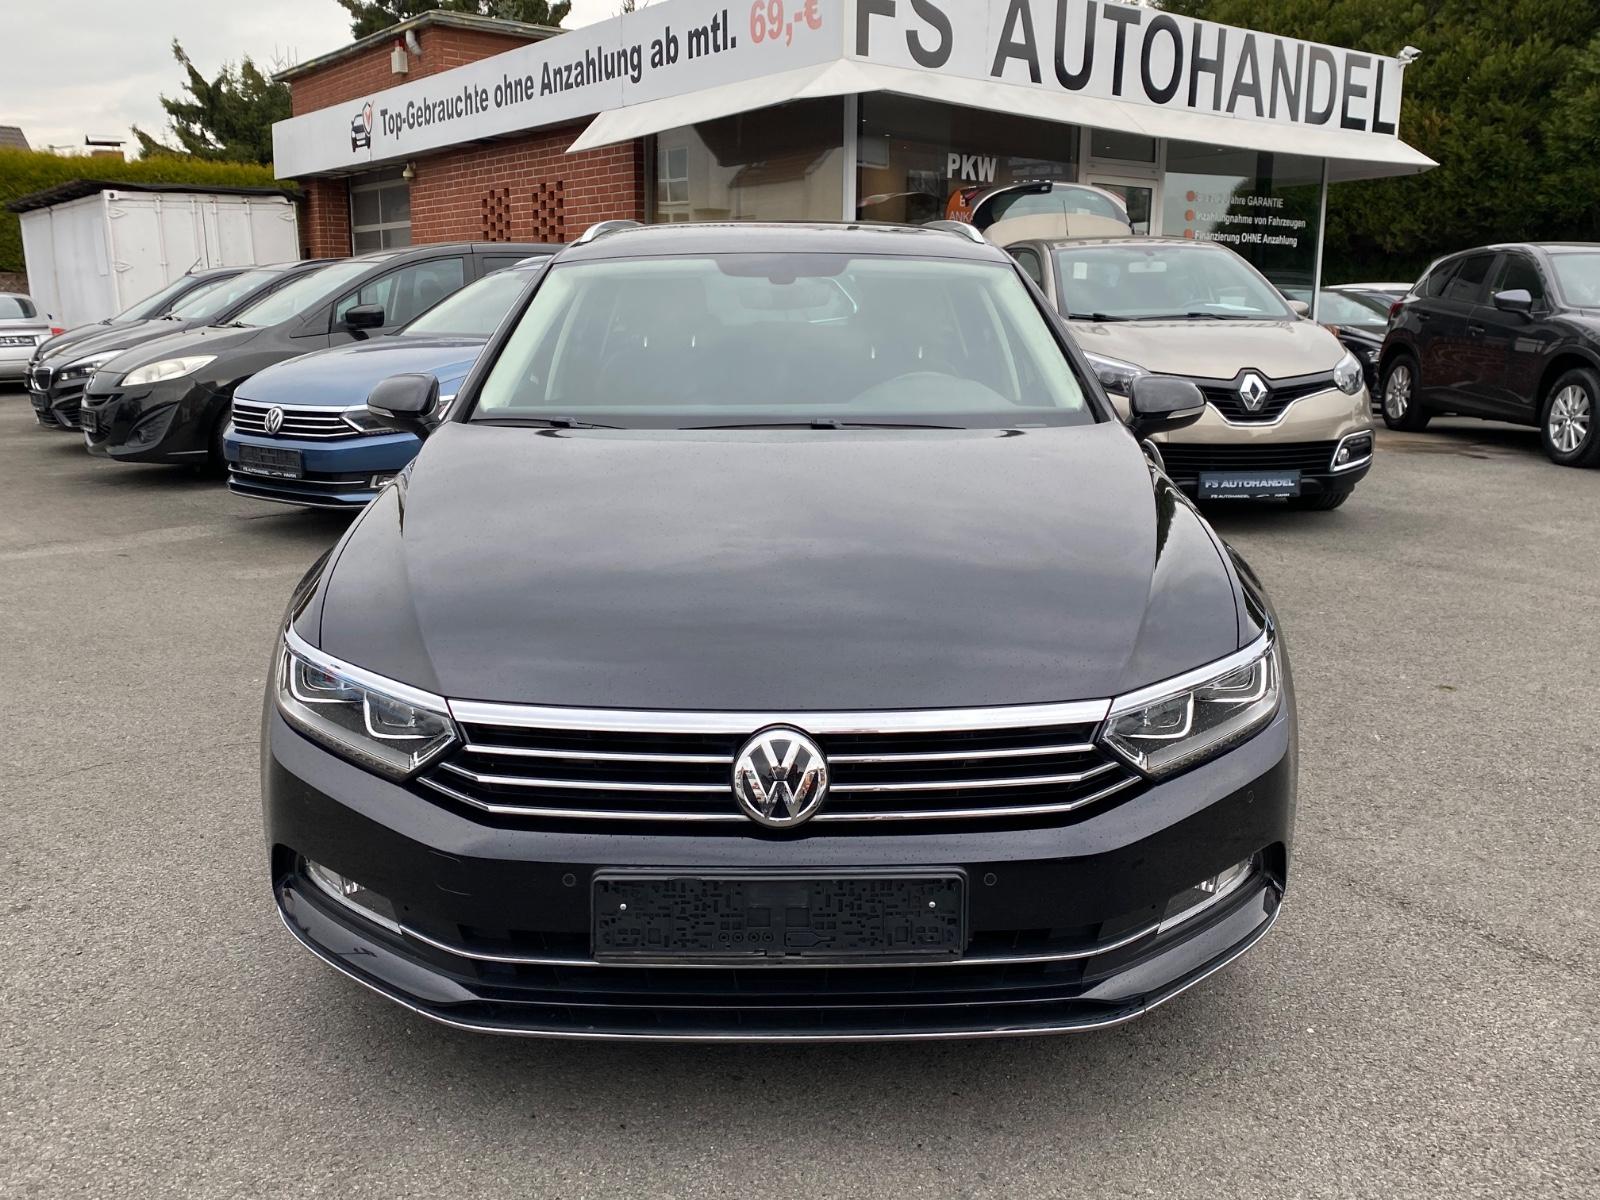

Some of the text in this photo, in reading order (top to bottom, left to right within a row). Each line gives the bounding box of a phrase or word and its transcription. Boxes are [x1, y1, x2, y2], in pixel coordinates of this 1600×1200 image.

[380, 84, 489, 140] Top-Gebrauchte
[494, 74, 534, 108] ohne
[540, 44, 643, 97] Anzahlung
[651, 26, 679, 68] ab
[688, 9, 737, 59] mtl.
[990, 0, 1395, 134] AUTOHANDEL
[946, 153, 997, 182] PKW
[1247, 196, 1284, 208] GARANTIE
[1254, 216, 1267, 225] von
[1267, 215, 1306, 229] Fahrzeugen
[1194, 230, 1298, 248] Finanzierung OHNE Anzahlung
[1220, 478, 1295, 488] AUTOHANDEL
